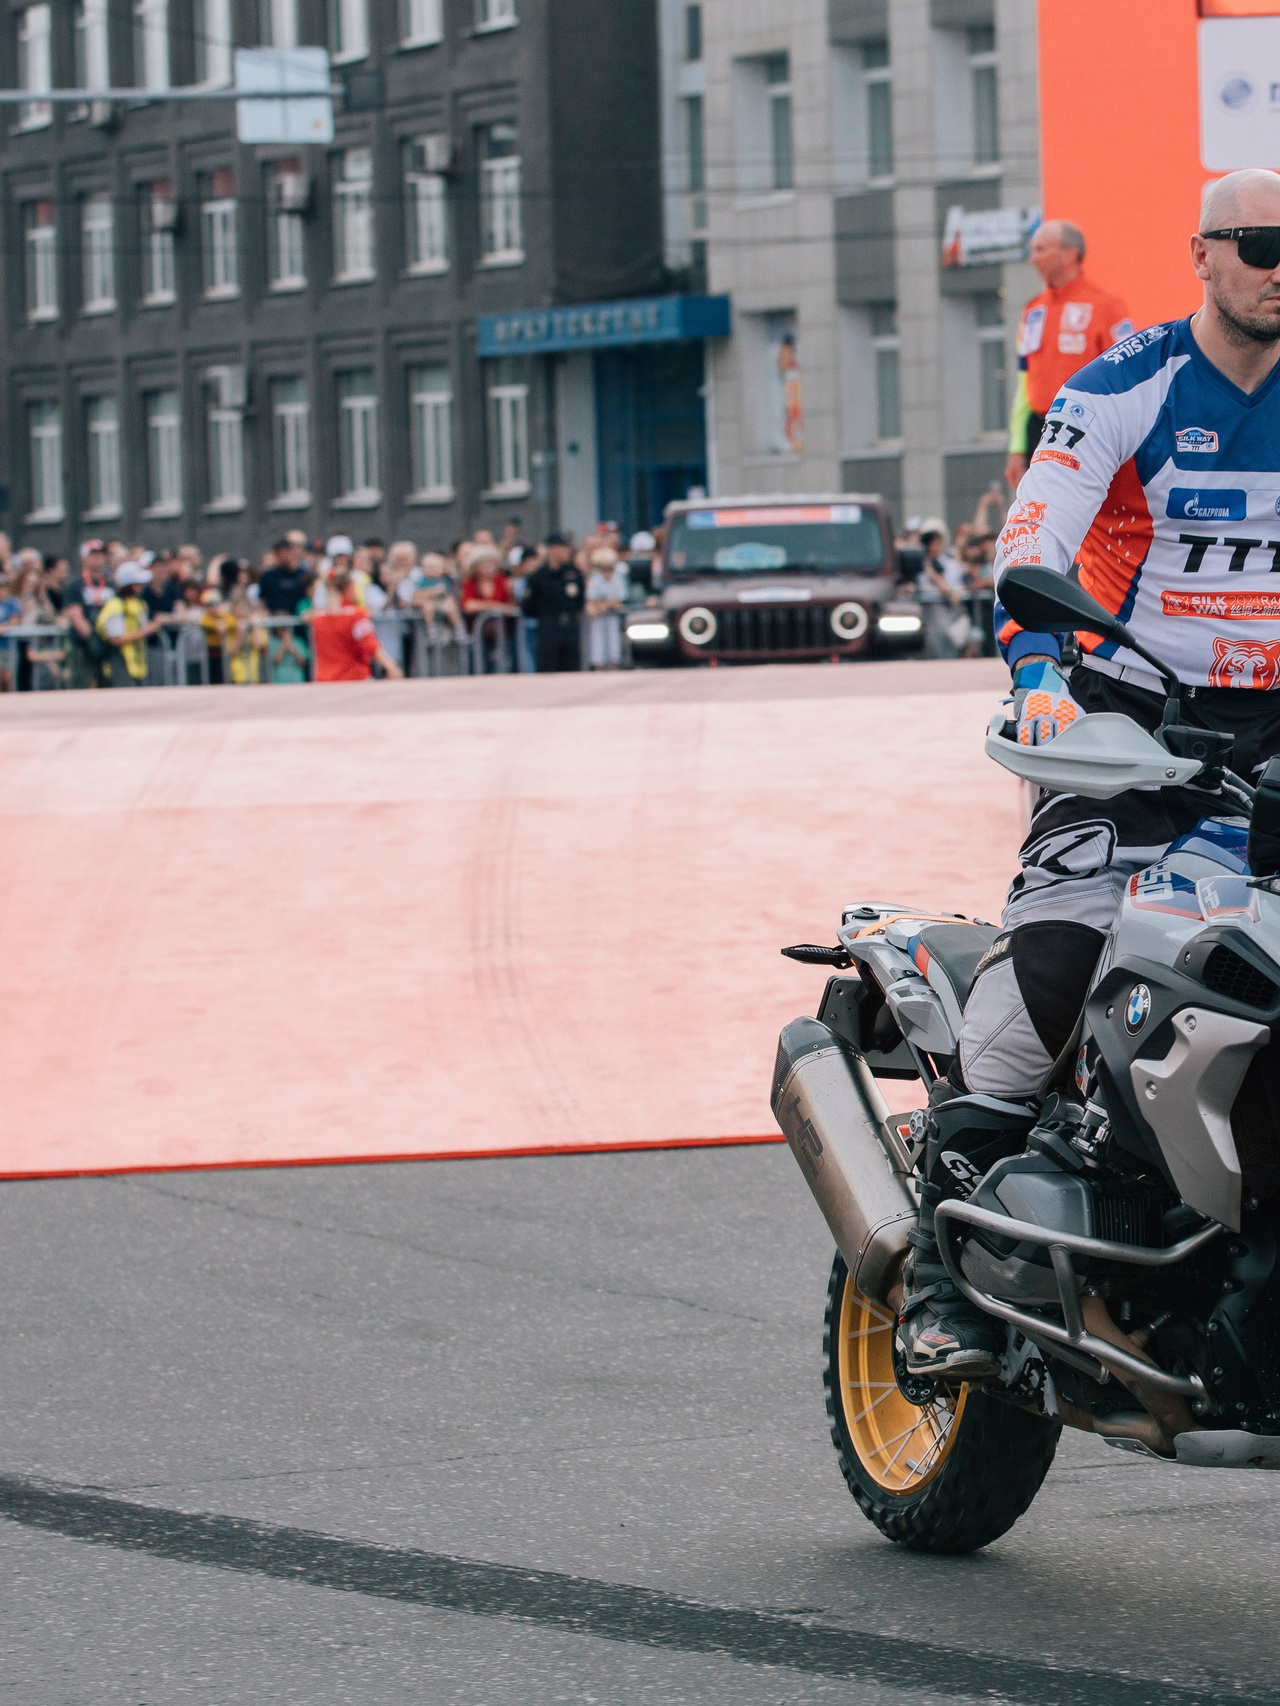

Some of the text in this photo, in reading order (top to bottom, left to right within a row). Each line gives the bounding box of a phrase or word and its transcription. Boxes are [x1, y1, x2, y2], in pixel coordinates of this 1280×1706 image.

[1040, 420, 1086, 450] 77
[1197, 507, 1230, 518] GAZPROM
[1001, 525, 1040, 545] WAY
[1003, 536, 1040, 558] RALLY
[1191, 595, 1227, 605] SILK
[1191, 604, 1228, 616] WAY
